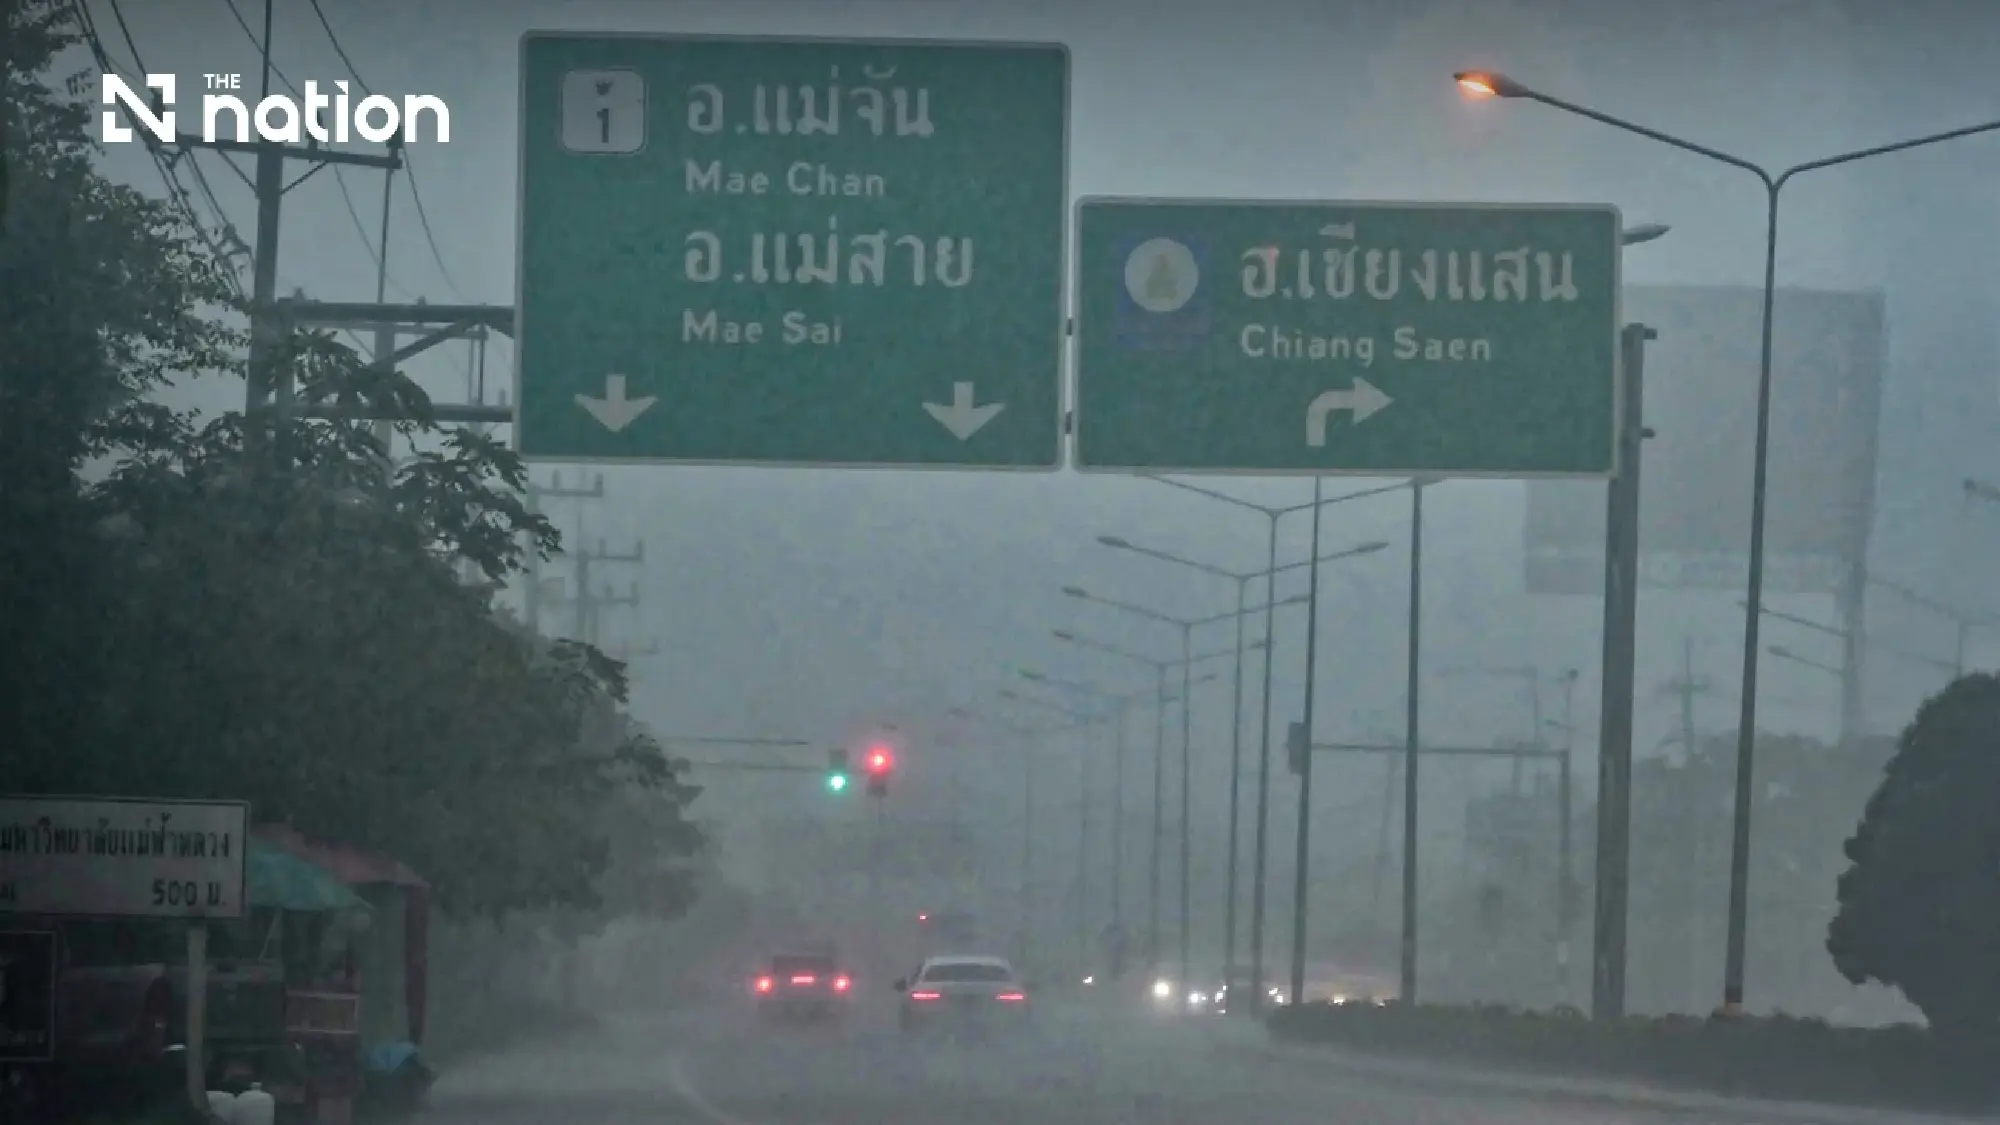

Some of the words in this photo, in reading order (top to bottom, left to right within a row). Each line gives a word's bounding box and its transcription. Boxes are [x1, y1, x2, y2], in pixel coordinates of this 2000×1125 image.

[686, 63, 935, 138] อ.แม่จัน
[596, 107, 610, 144] 1
[685, 160, 770, 195] Mae
[786, 162, 886, 197] Chan
[683, 215, 975, 287] อ.แม่สาย
[681, 308, 764, 344] Mae
[781, 310, 843, 345] Sai
[1239, 323, 1375, 366] Chiang
[1392, 325, 1492, 362] Saen
[151, 878, 199, 908] 500
